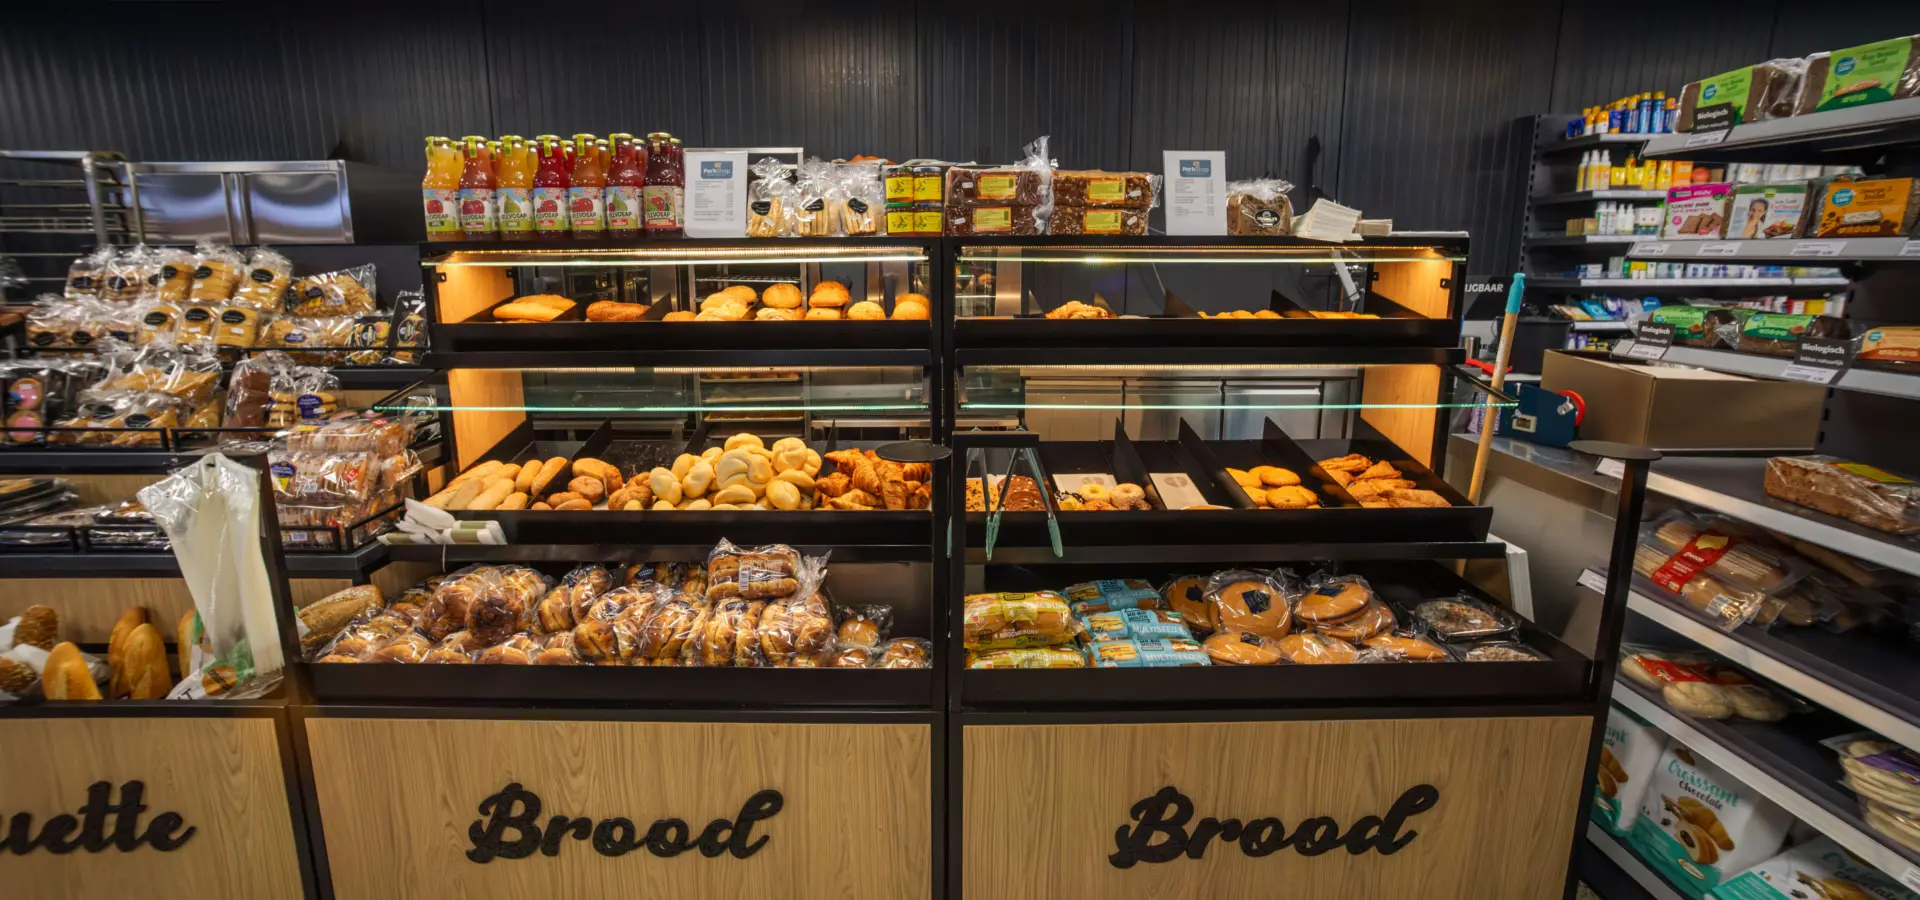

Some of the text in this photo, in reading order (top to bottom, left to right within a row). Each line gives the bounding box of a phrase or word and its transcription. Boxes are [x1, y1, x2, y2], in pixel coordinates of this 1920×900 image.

[1697, 109, 1728, 120] Biologisch
[1641, 326, 1670, 335] Biologisch
[1802, 343, 1845, 354] Biologisch
[1132, 624, 1176, 633] MULTISEED
[1146, 653, 1195, 661] MULTISEED
[1668, 759, 1744, 807] Croissant
[1679, 780, 1723, 811] Chocolate
[465, 783, 784, 864] Brood
[1108, 784, 1439, 869] Brood
